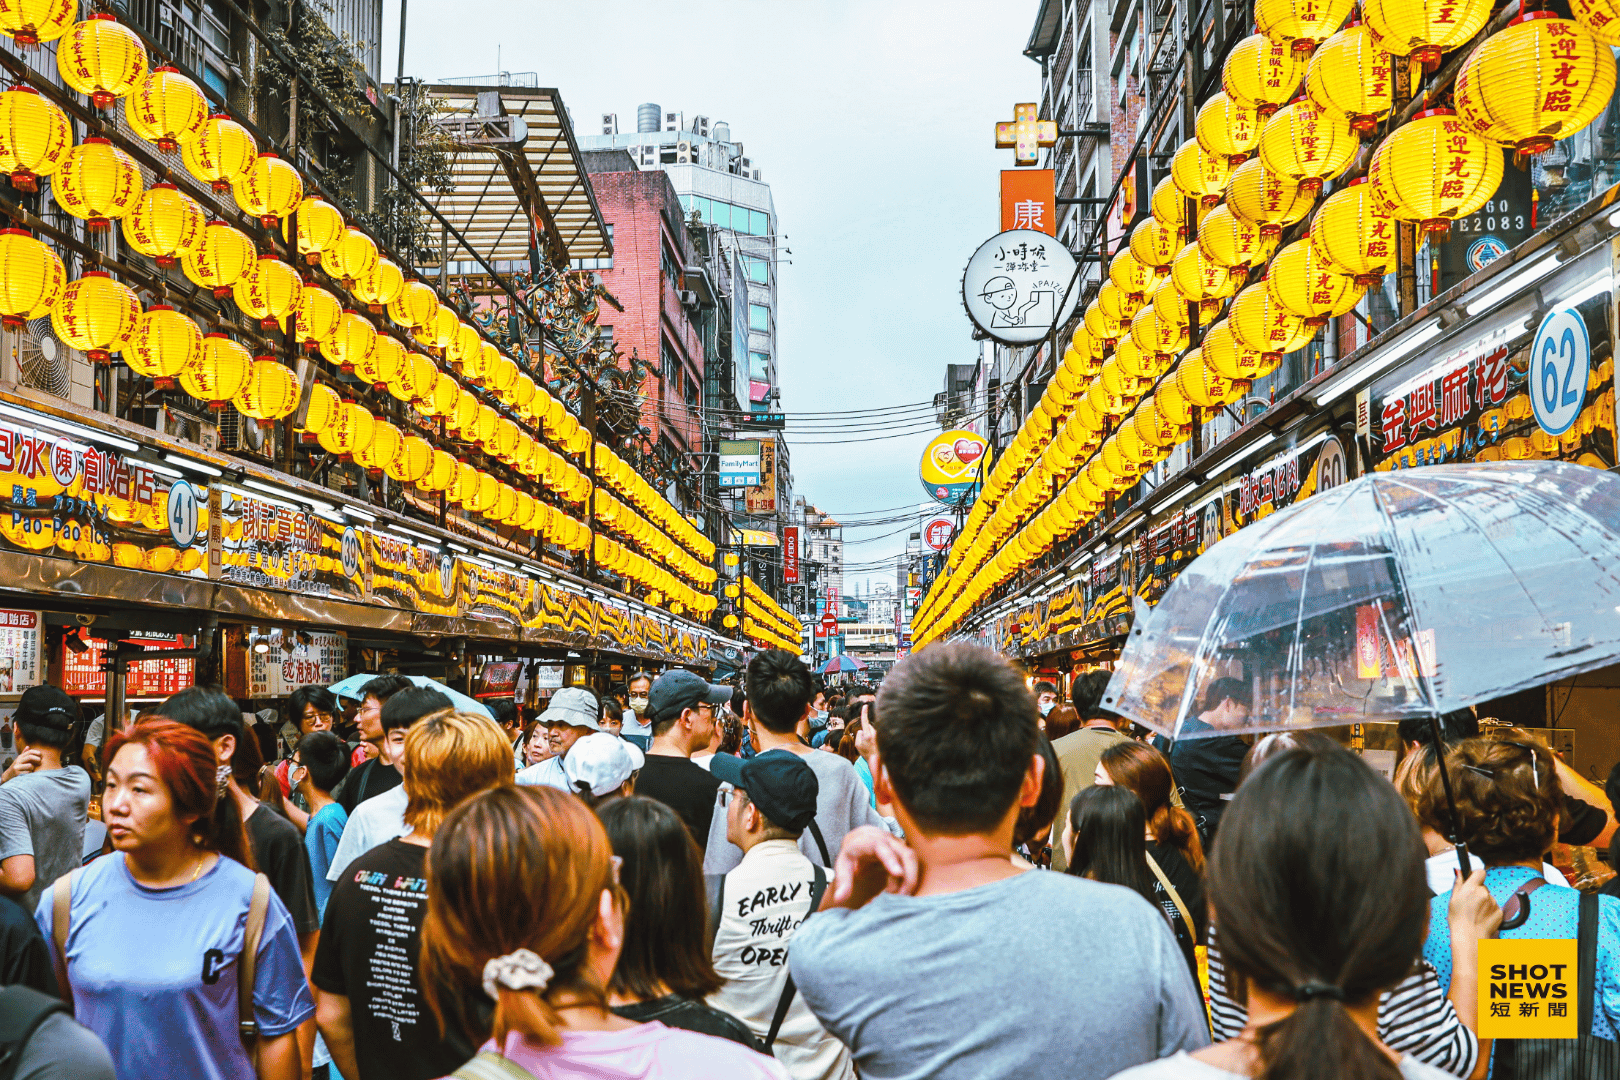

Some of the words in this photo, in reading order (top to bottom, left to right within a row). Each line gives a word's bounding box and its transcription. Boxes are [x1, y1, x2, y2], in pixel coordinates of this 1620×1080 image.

[1541, 22, 1581, 113] 歡迎光臨
[1439, 121, 1471, 199] 歡迎光臨
[1450, 215, 1525, 232] E2083
[1473, 200, 1509, 214] 60
[994, 241, 1047, 261] 小時候
[1541, 327, 1578, 414] 62
[55, 446, 73, 479] 陳
[82, 445, 155, 506] 創始店
[721, 459, 759, 469] FamilyMart
[1322, 453, 1343, 488] 60
[12, 483, 38, 508] 陳家
[12, 509, 82, 542] Pao-Pao
[89, 524, 110, 545] Ice
[173, 492, 193, 537] 41
[344, 535, 358, 570] 39
[787, 536, 796, 574] SHISEIDO
[726, 648, 736, 659] 25
[737, 881, 802, 918] EARLY
[749, 915, 792, 938] Thrift
